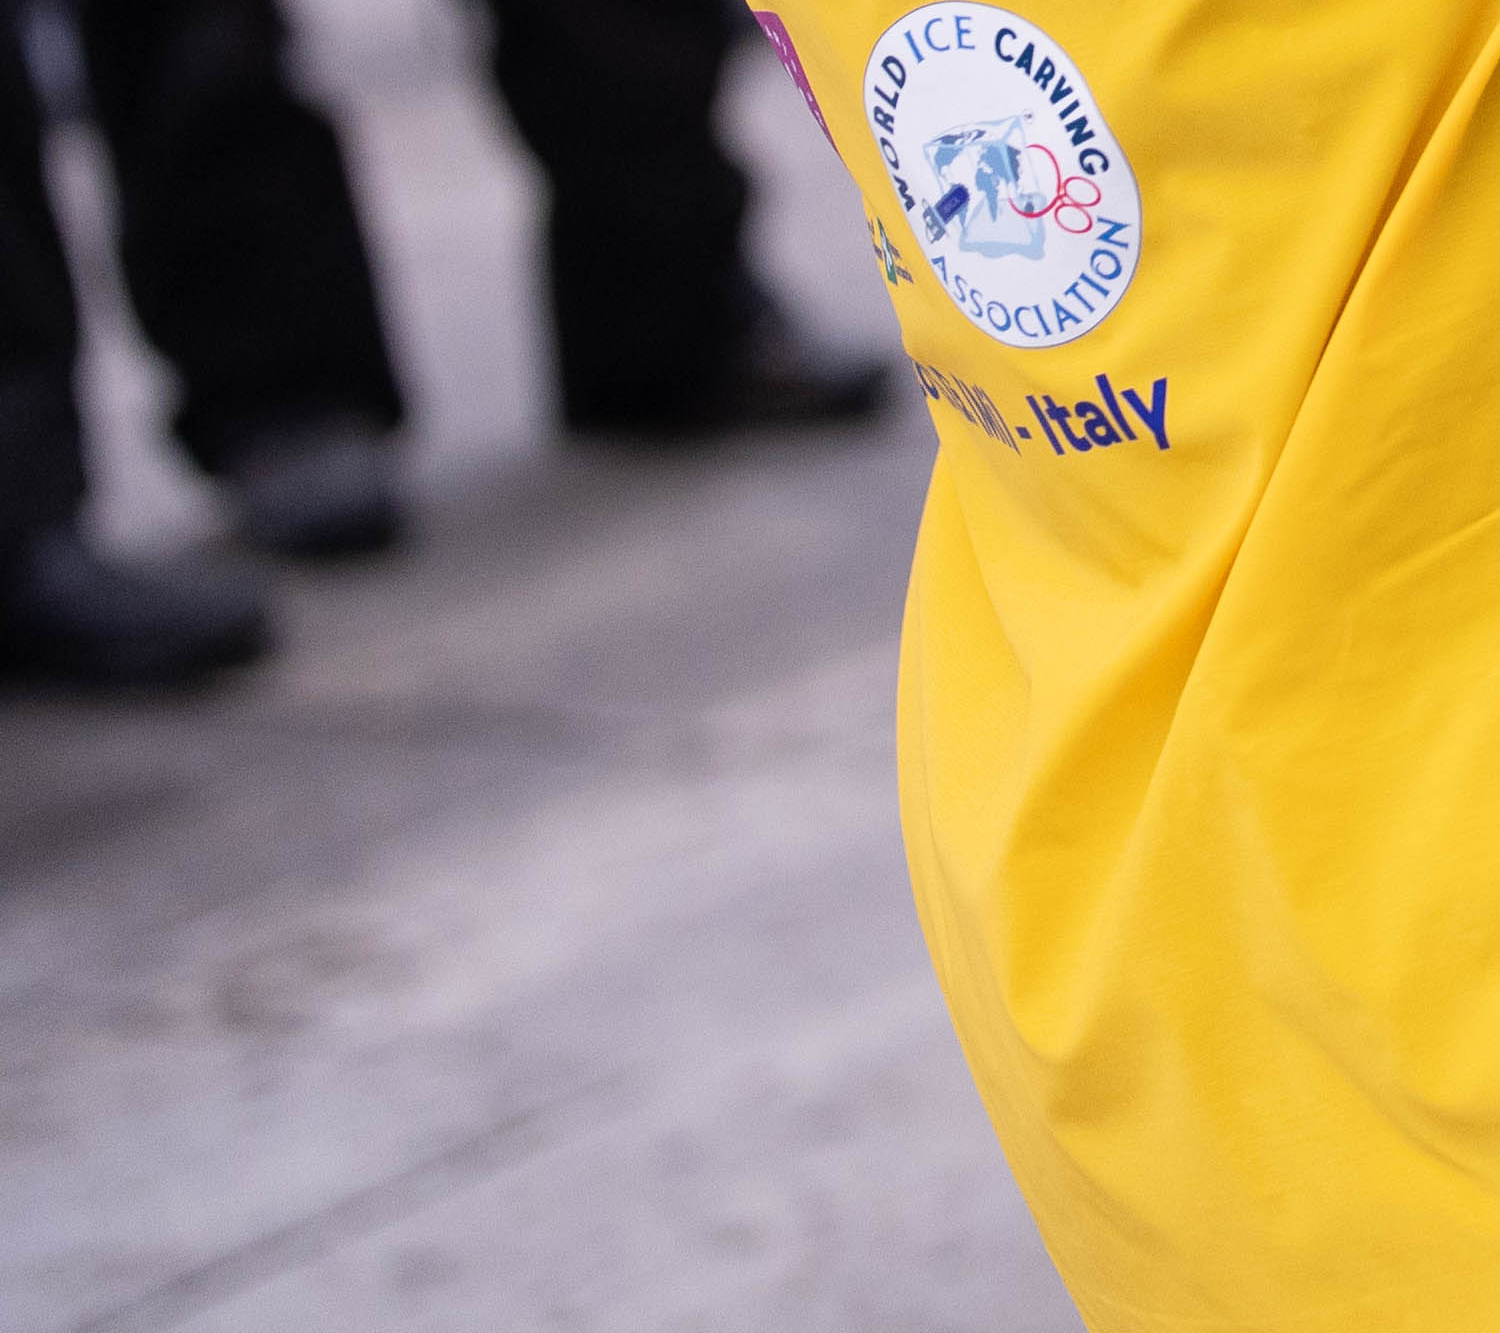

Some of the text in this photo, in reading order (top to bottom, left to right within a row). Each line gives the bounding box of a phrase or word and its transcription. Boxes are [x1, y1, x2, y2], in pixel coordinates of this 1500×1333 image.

[873, 55, 915, 212] WORLD
[904, 15, 976, 64] ICE
[995, 28, 1109, 175] CARVING
[932, 217, 1131, 337] ASSOCIATION
[1025, 373, 1170, 455] Italy
